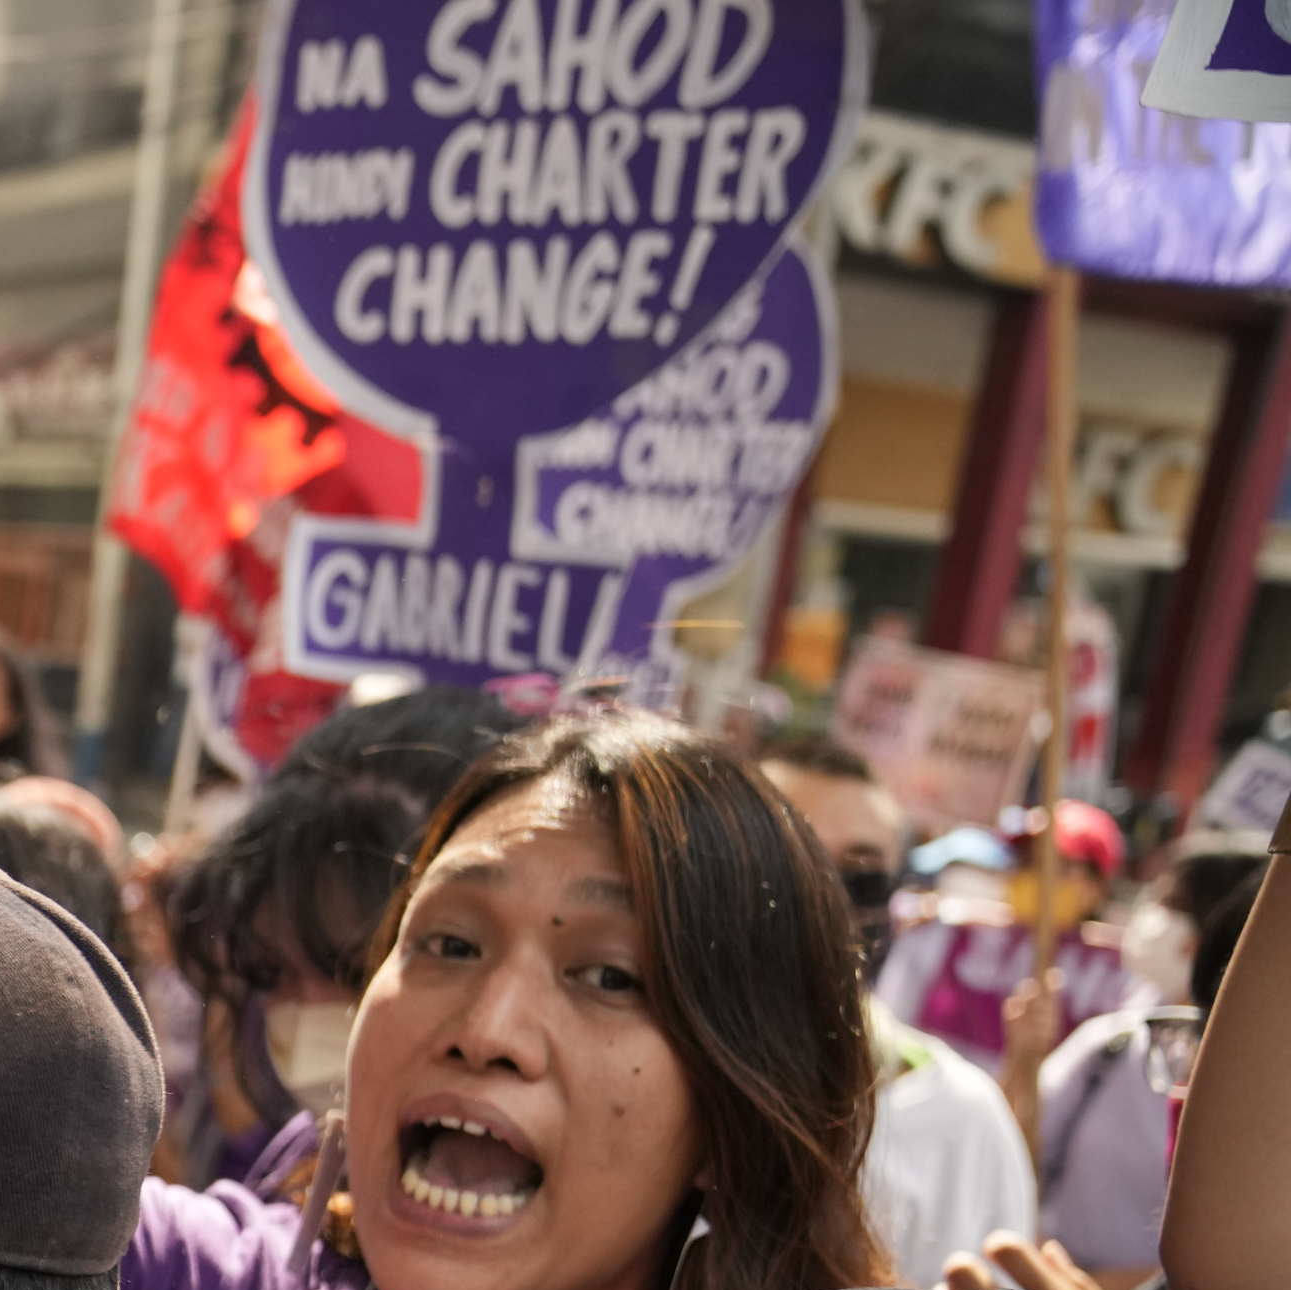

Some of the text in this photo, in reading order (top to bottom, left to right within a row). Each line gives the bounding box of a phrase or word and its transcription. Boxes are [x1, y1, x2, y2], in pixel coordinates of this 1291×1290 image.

[294, 0, 774, 118] NA SAHOD
[429, 106, 807, 229] CHARTER
[829, 137, 1035, 284] KFC
[333, 224, 715, 346] CHANGE!
